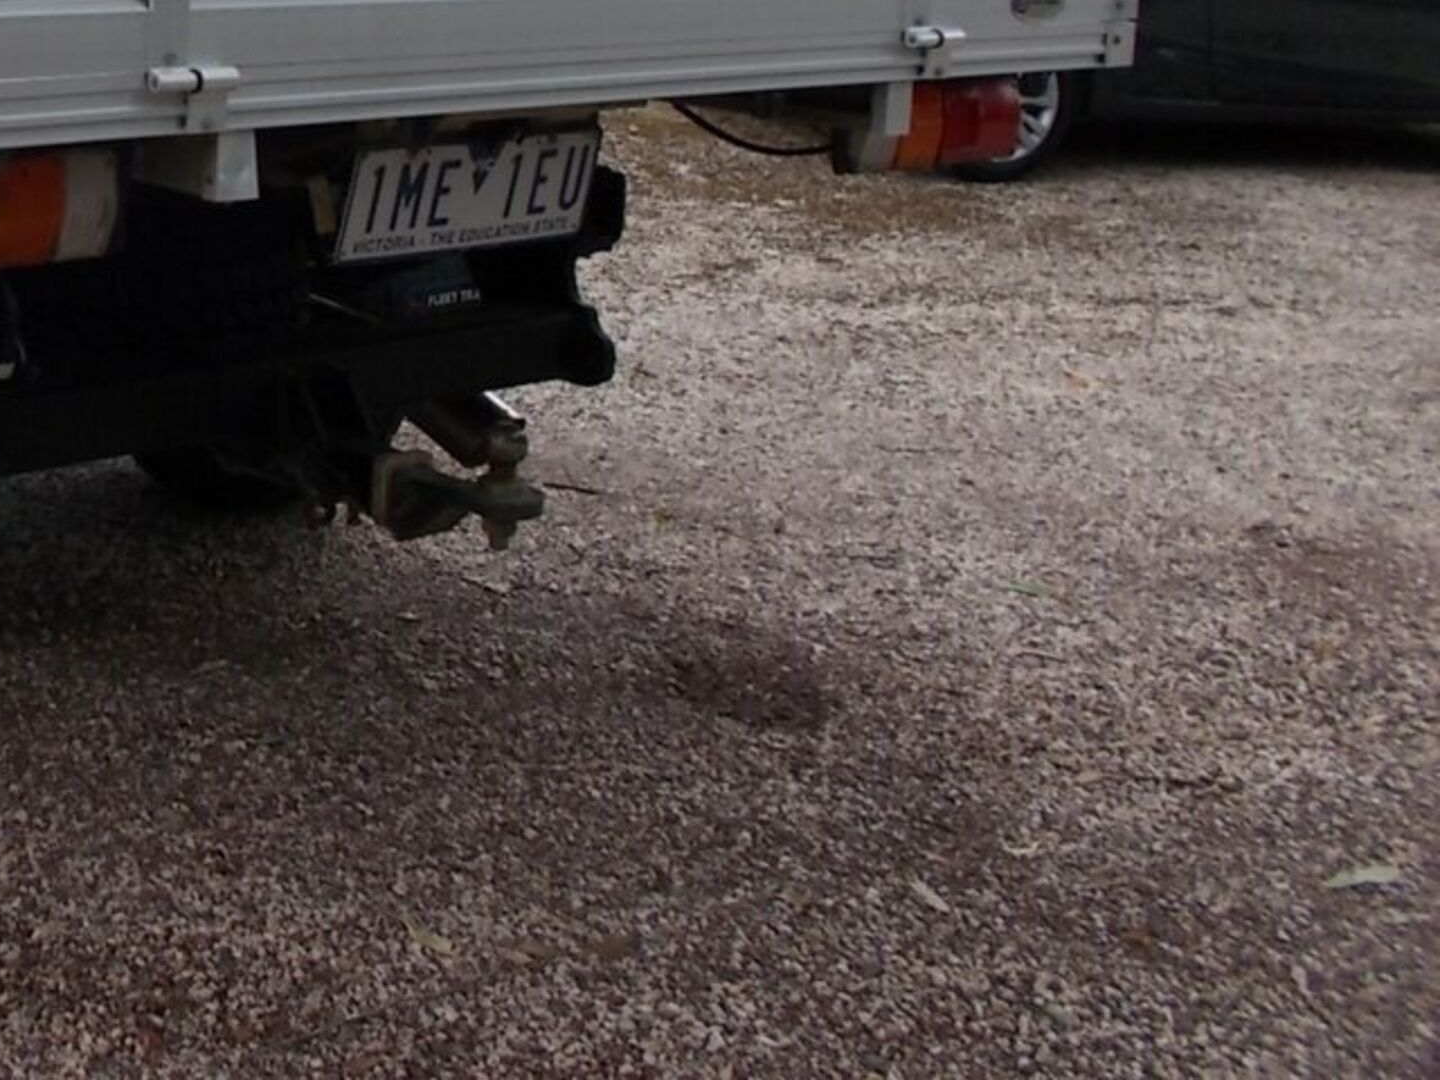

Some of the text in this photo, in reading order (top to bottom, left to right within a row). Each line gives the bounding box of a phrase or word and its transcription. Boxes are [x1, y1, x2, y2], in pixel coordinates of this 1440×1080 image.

[365, 144, 591, 234] 1ME 1EU
[352, 218, 569, 254] VICTORIA THE EDUCATION STATE
